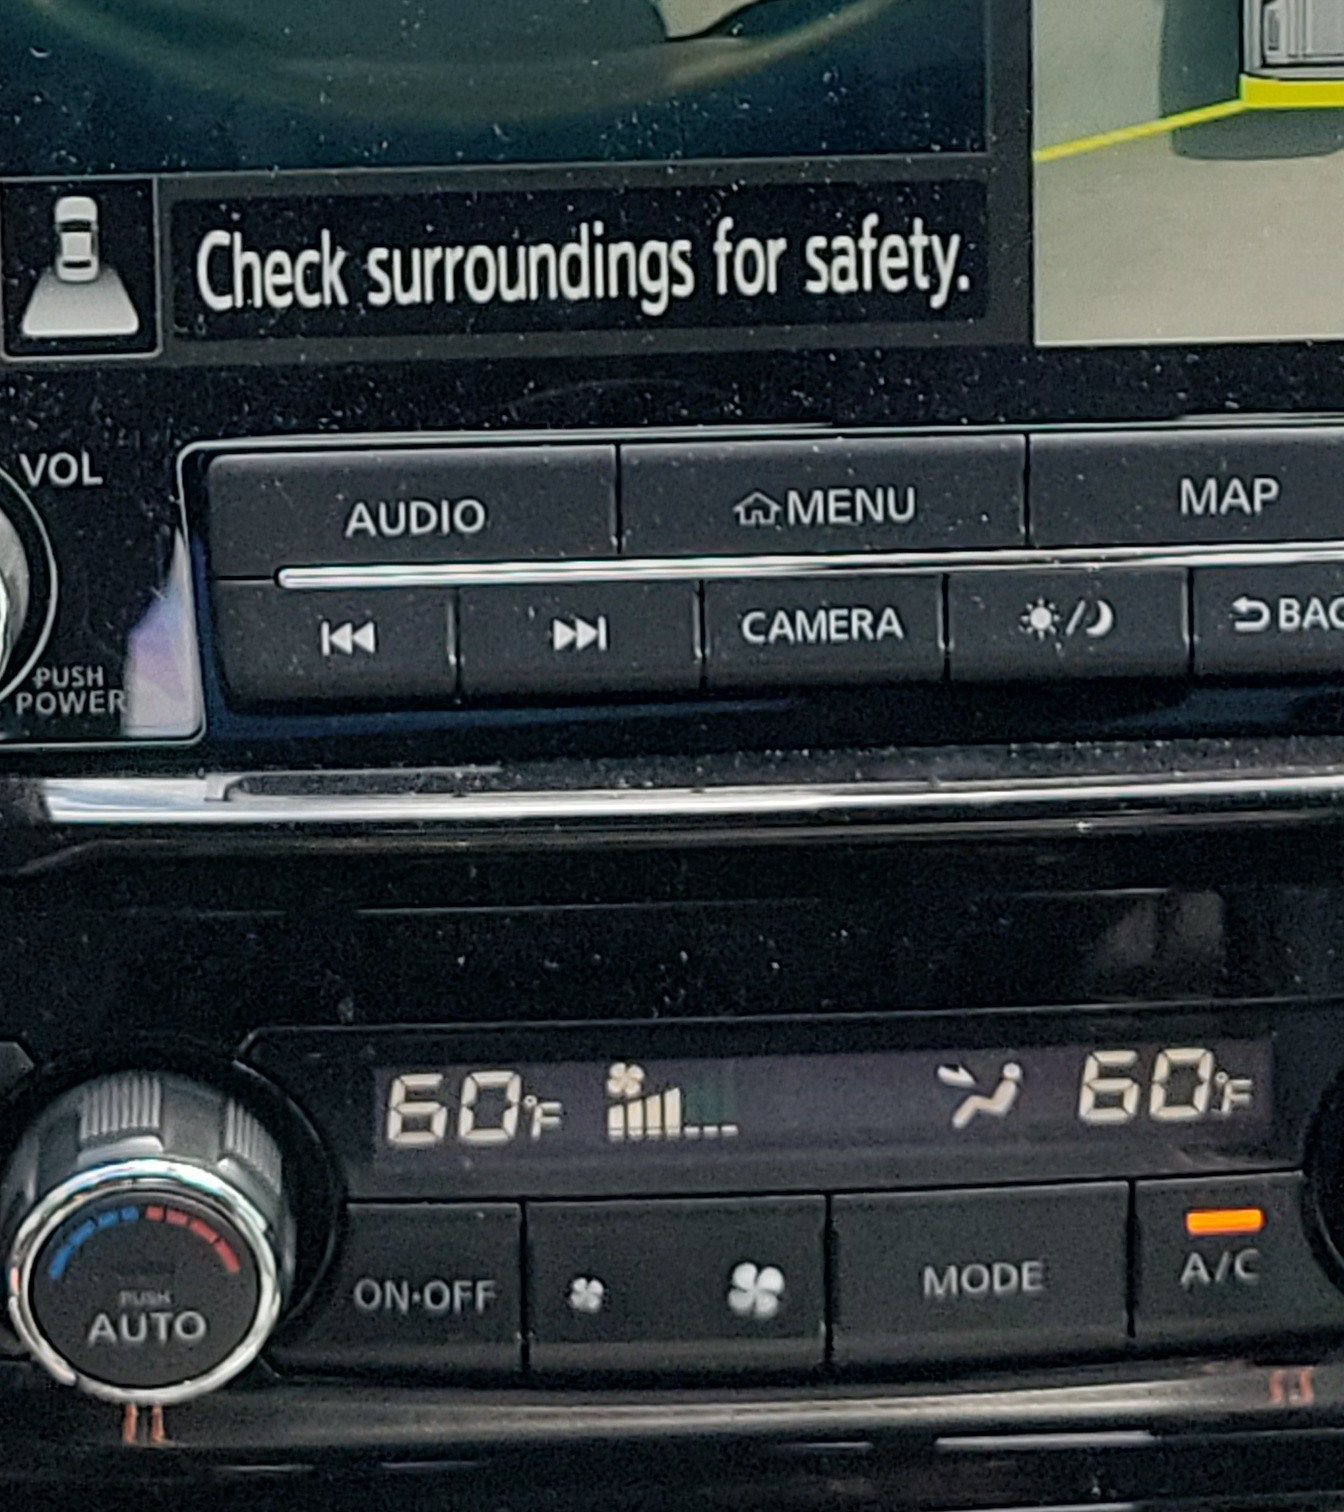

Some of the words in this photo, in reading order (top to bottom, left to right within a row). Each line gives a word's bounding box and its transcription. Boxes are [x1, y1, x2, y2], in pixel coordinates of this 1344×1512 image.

[196, 228, 348, 312] Check
[367, 222, 696, 318] surroundings
[712, 216, 789, 292] for
[805, 212, 973, 310] safety.
[19, 451, 104, 488] VOL
[786, 488, 917, 526] MENU
[1179, 478, 1280, 516] MAP
[344, 499, 488, 538] AUDIO
[741, 608, 904, 645] CAMERA
[33, 665, 104, 688] PUSH
[15, 690, 126, 715] POWER
[923, 1262, 1044, 1300] MODE
[1180, 1250, 1260, 1288] A/C
[87, 1310, 208, 1346] AUTO
